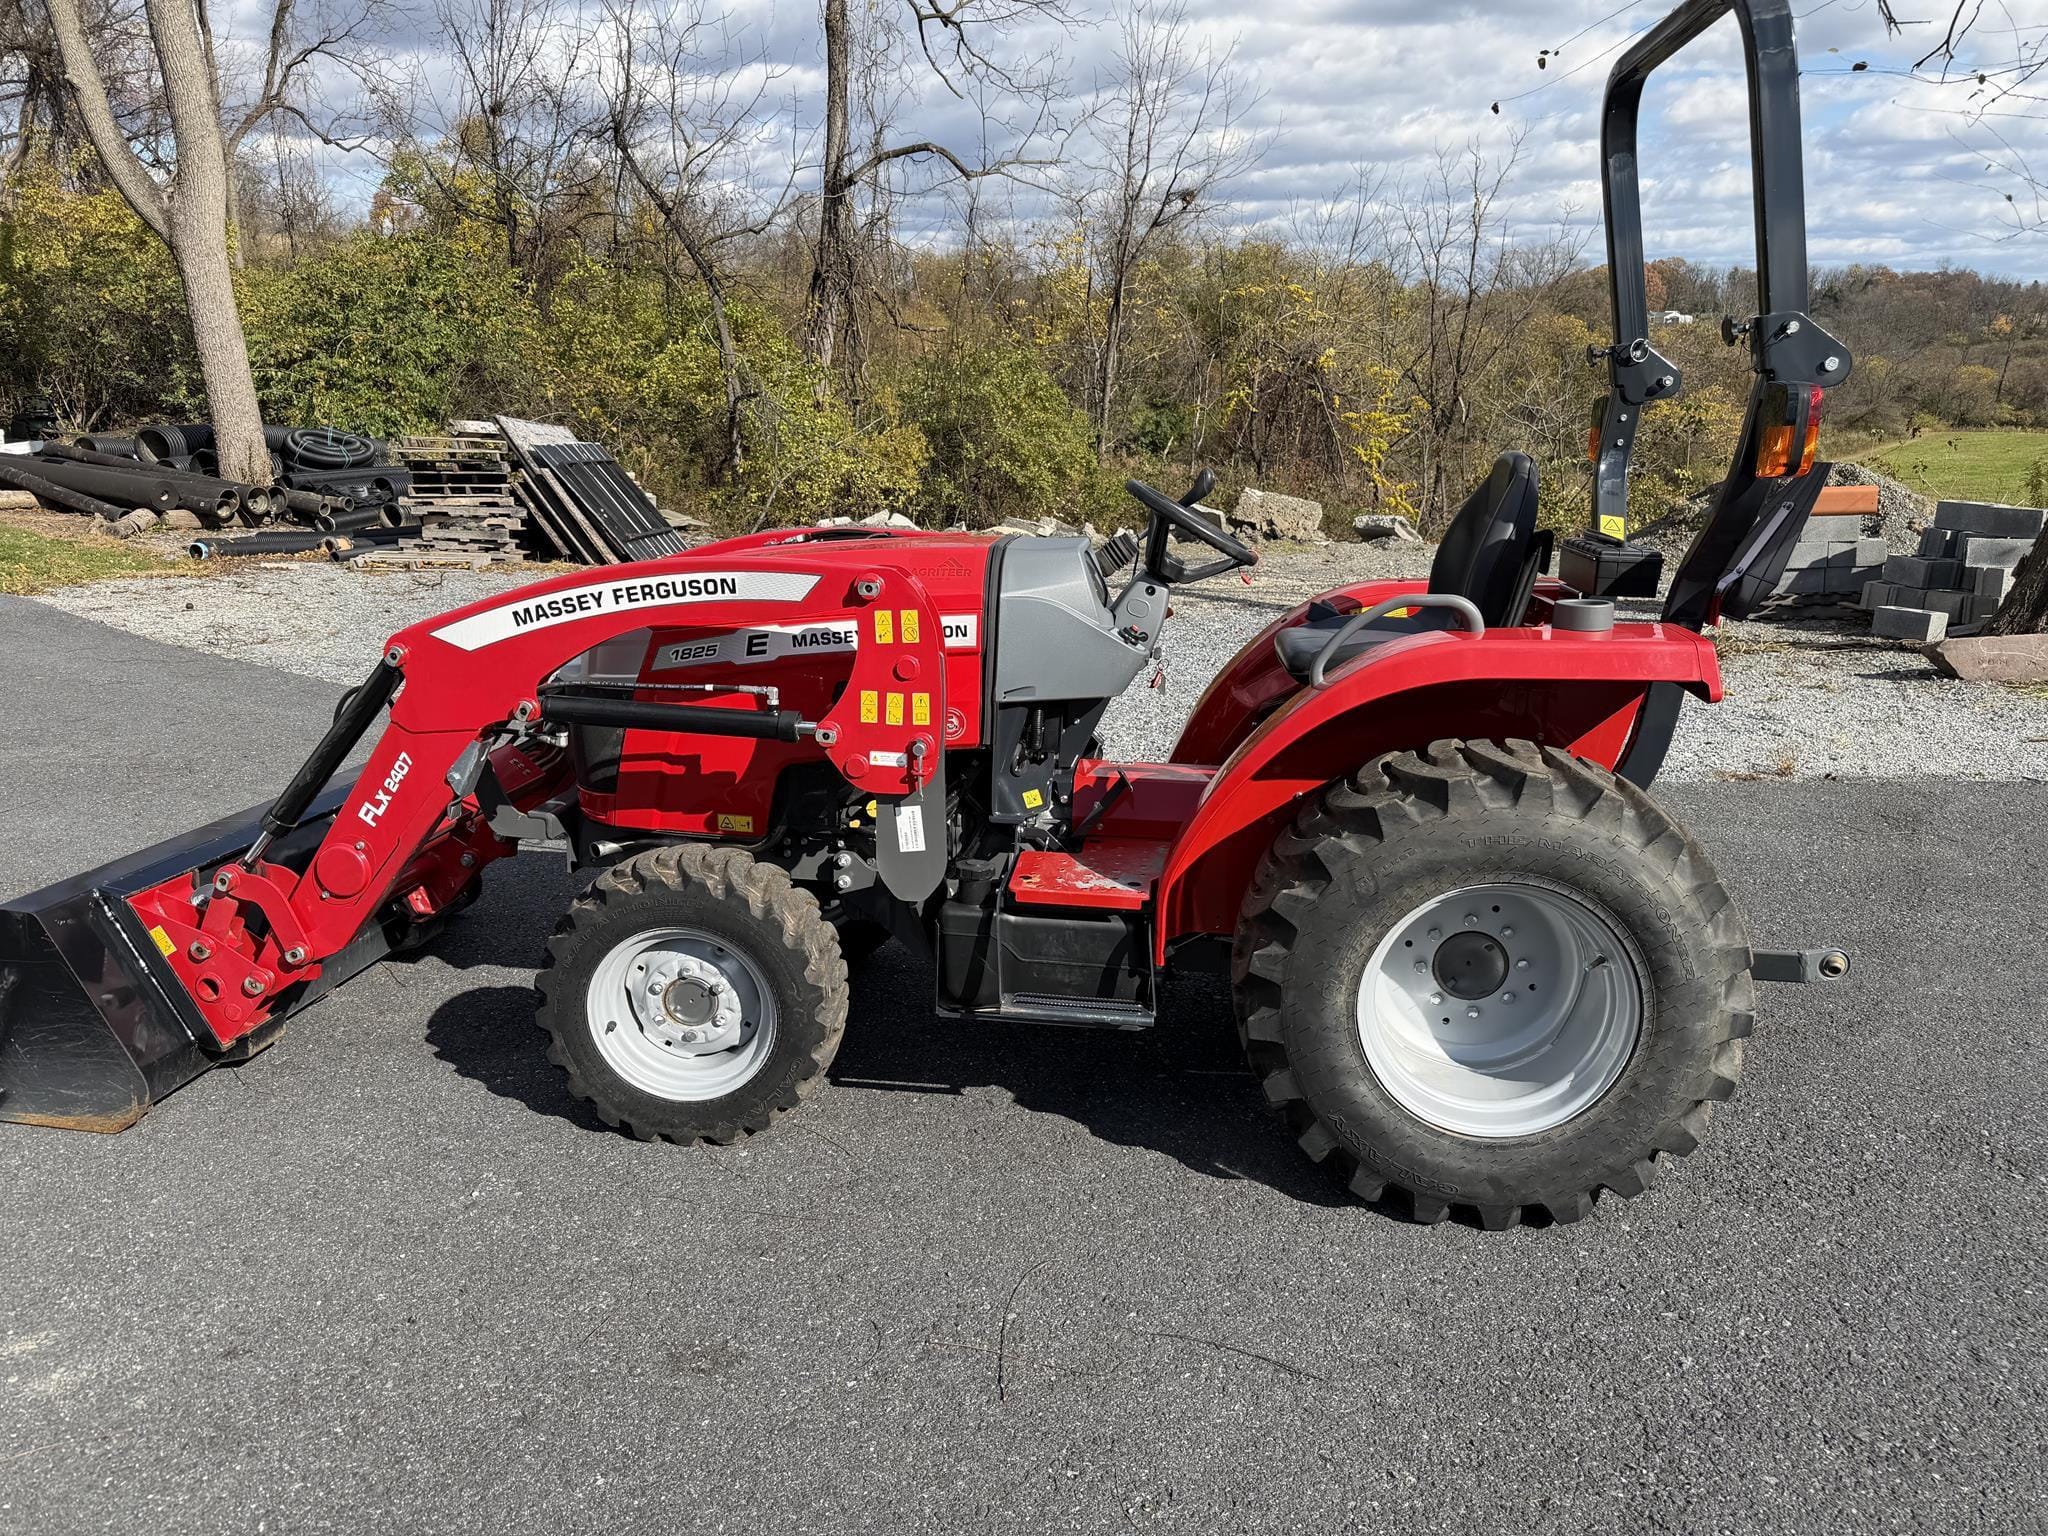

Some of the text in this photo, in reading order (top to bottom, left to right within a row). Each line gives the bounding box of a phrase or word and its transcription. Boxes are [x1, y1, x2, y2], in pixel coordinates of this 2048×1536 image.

[512, 577, 737, 627] MASSEY FERGUSON
[670, 643, 718, 661] 1825
[745, 633, 770, 656] E
[792, 630, 858, 648] MASSE
[358, 751, 412, 827] FLX 2407
[1538, 837, 1695, 981] MARATHONER
[1327, 1111, 1459, 1194] GALAXY
